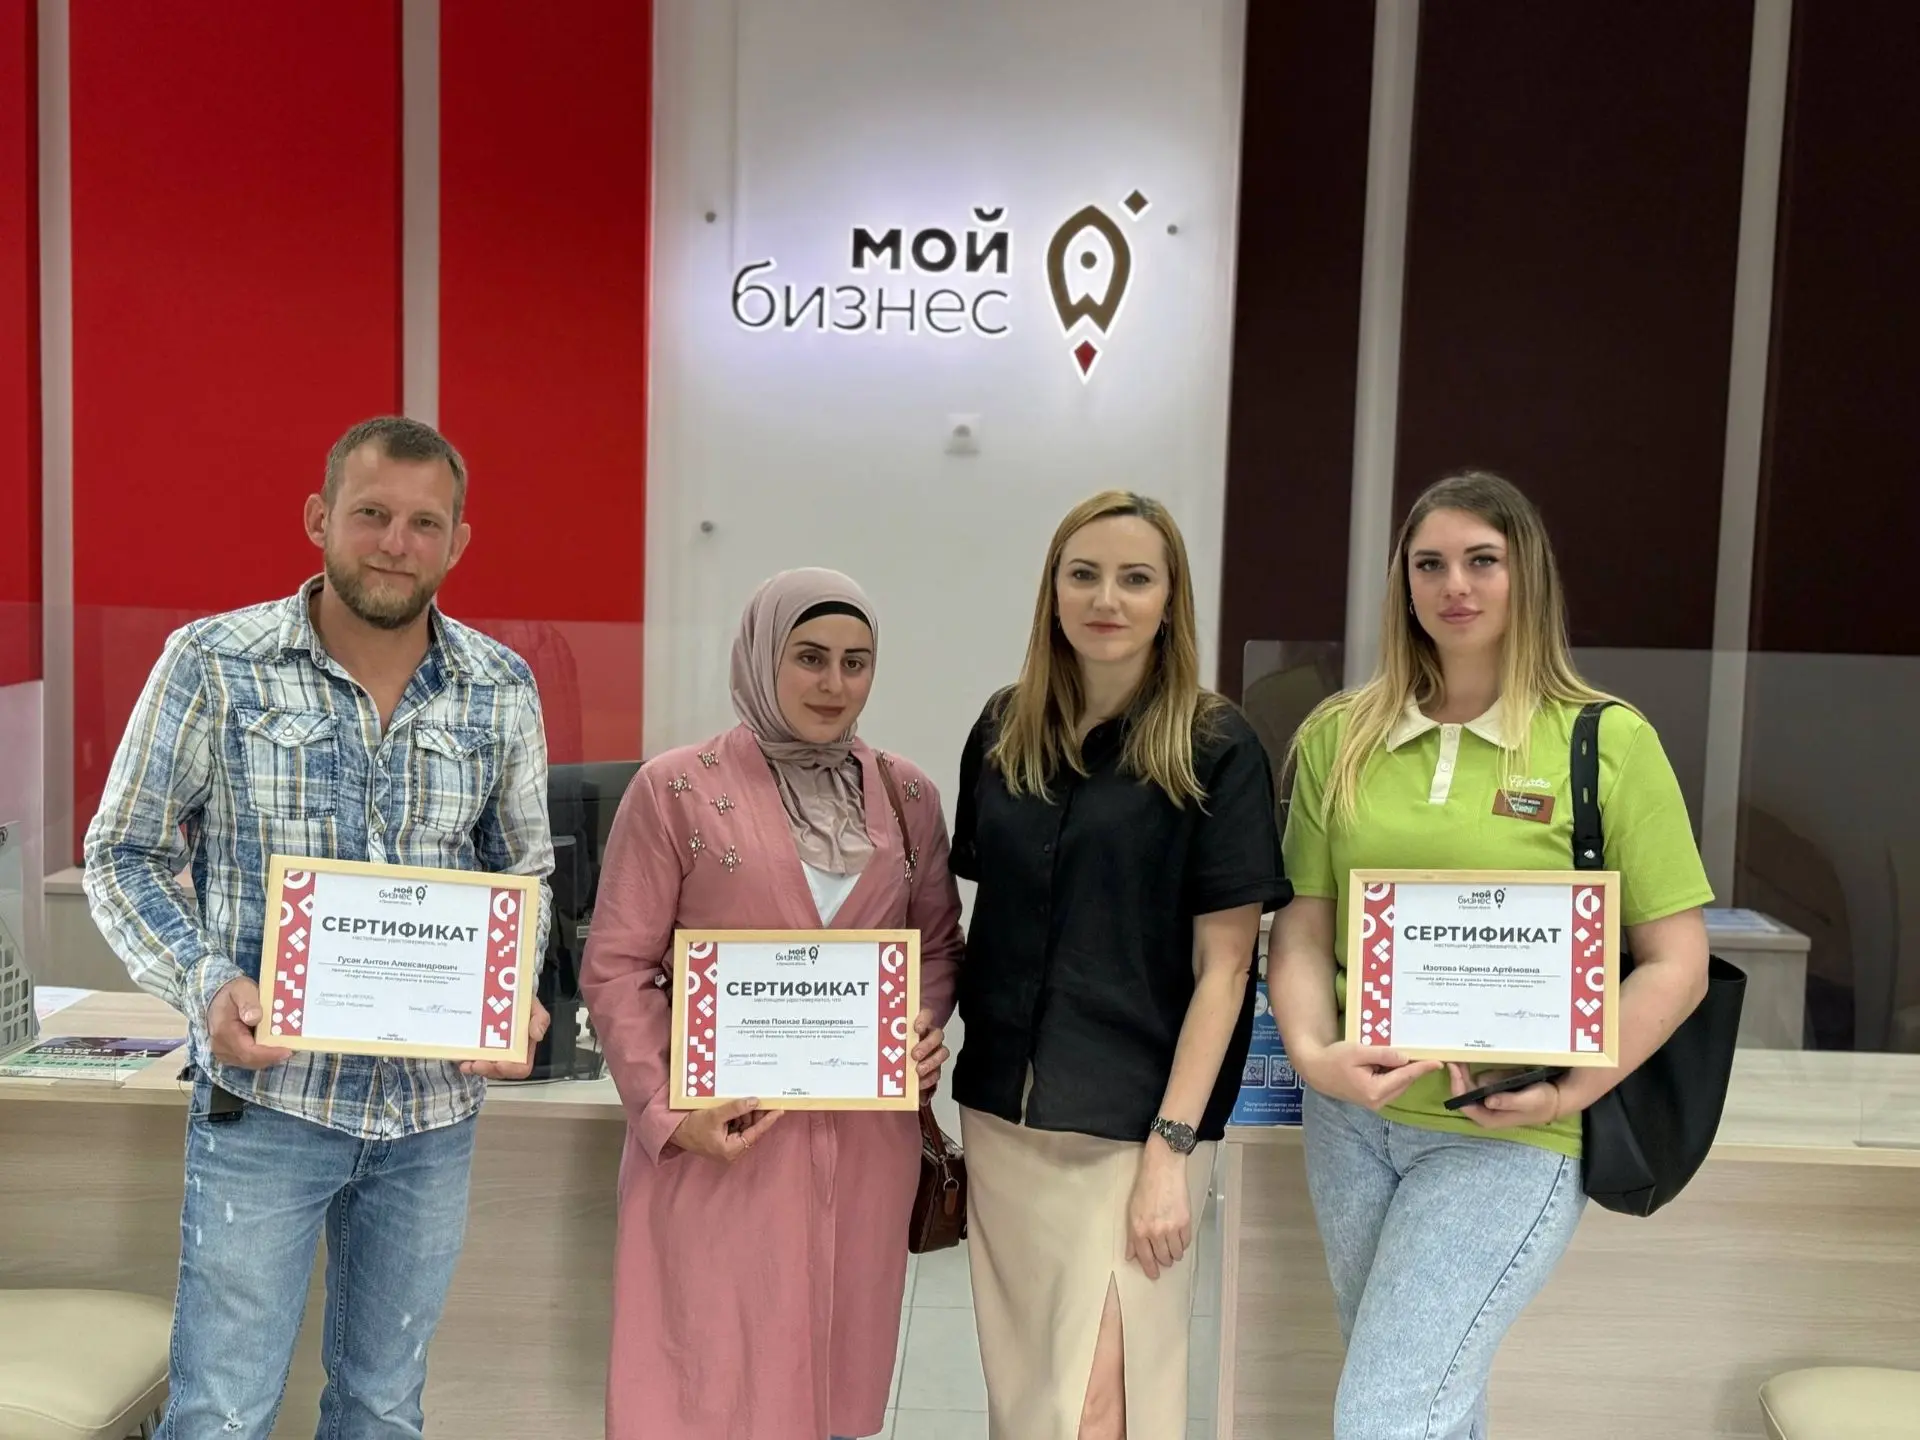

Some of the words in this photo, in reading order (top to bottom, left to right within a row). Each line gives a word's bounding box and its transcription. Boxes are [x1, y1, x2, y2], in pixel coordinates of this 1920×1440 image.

[852, 207, 1009, 274] мой
[732, 260, 1009, 335] бизнес
[322, 916, 478, 942] СЕРТИФИКАТ
[1404, 925, 1561, 943] СЕРТИФИКАТ
[338, 956, 361, 966] Гусак
[363, 958, 389, 966] Антон
[391, 960, 457, 971] Александрович
[1423, 964, 1457, 972] Изотова
[1459, 965, 1490, 974] Карина
[1492, 965, 1540, 975] Артёмовна
[726, 981, 869, 996] СЕРТИФИКАТ
[741, 1018, 770, 1026] Алиева
